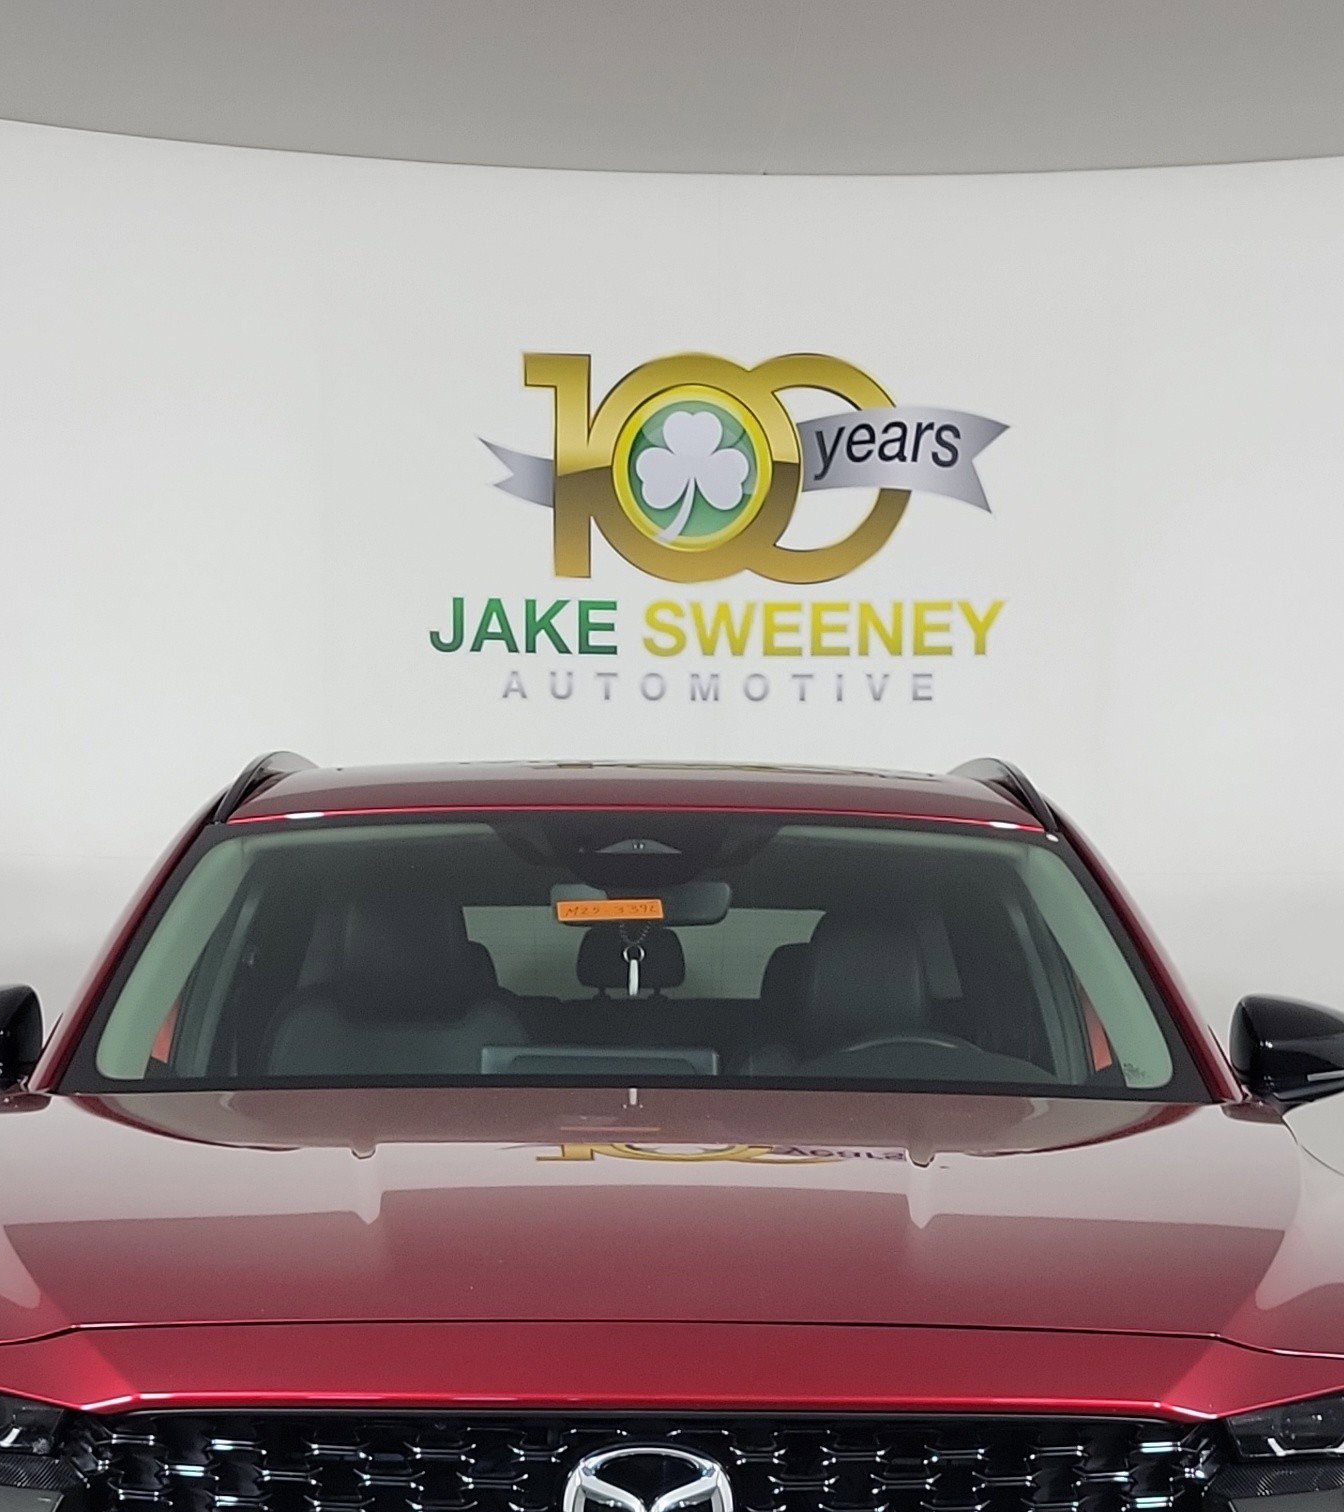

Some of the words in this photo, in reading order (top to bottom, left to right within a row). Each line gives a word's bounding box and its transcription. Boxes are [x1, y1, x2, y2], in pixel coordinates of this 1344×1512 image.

[522, 351, 913, 585] 100
[812, 418, 962, 481] years
[429, 596, 618, 656] JAKE
[641, 599, 1008, 657] SWEENEY
[501, 671, 936, 702] AUTOMOTIVE
